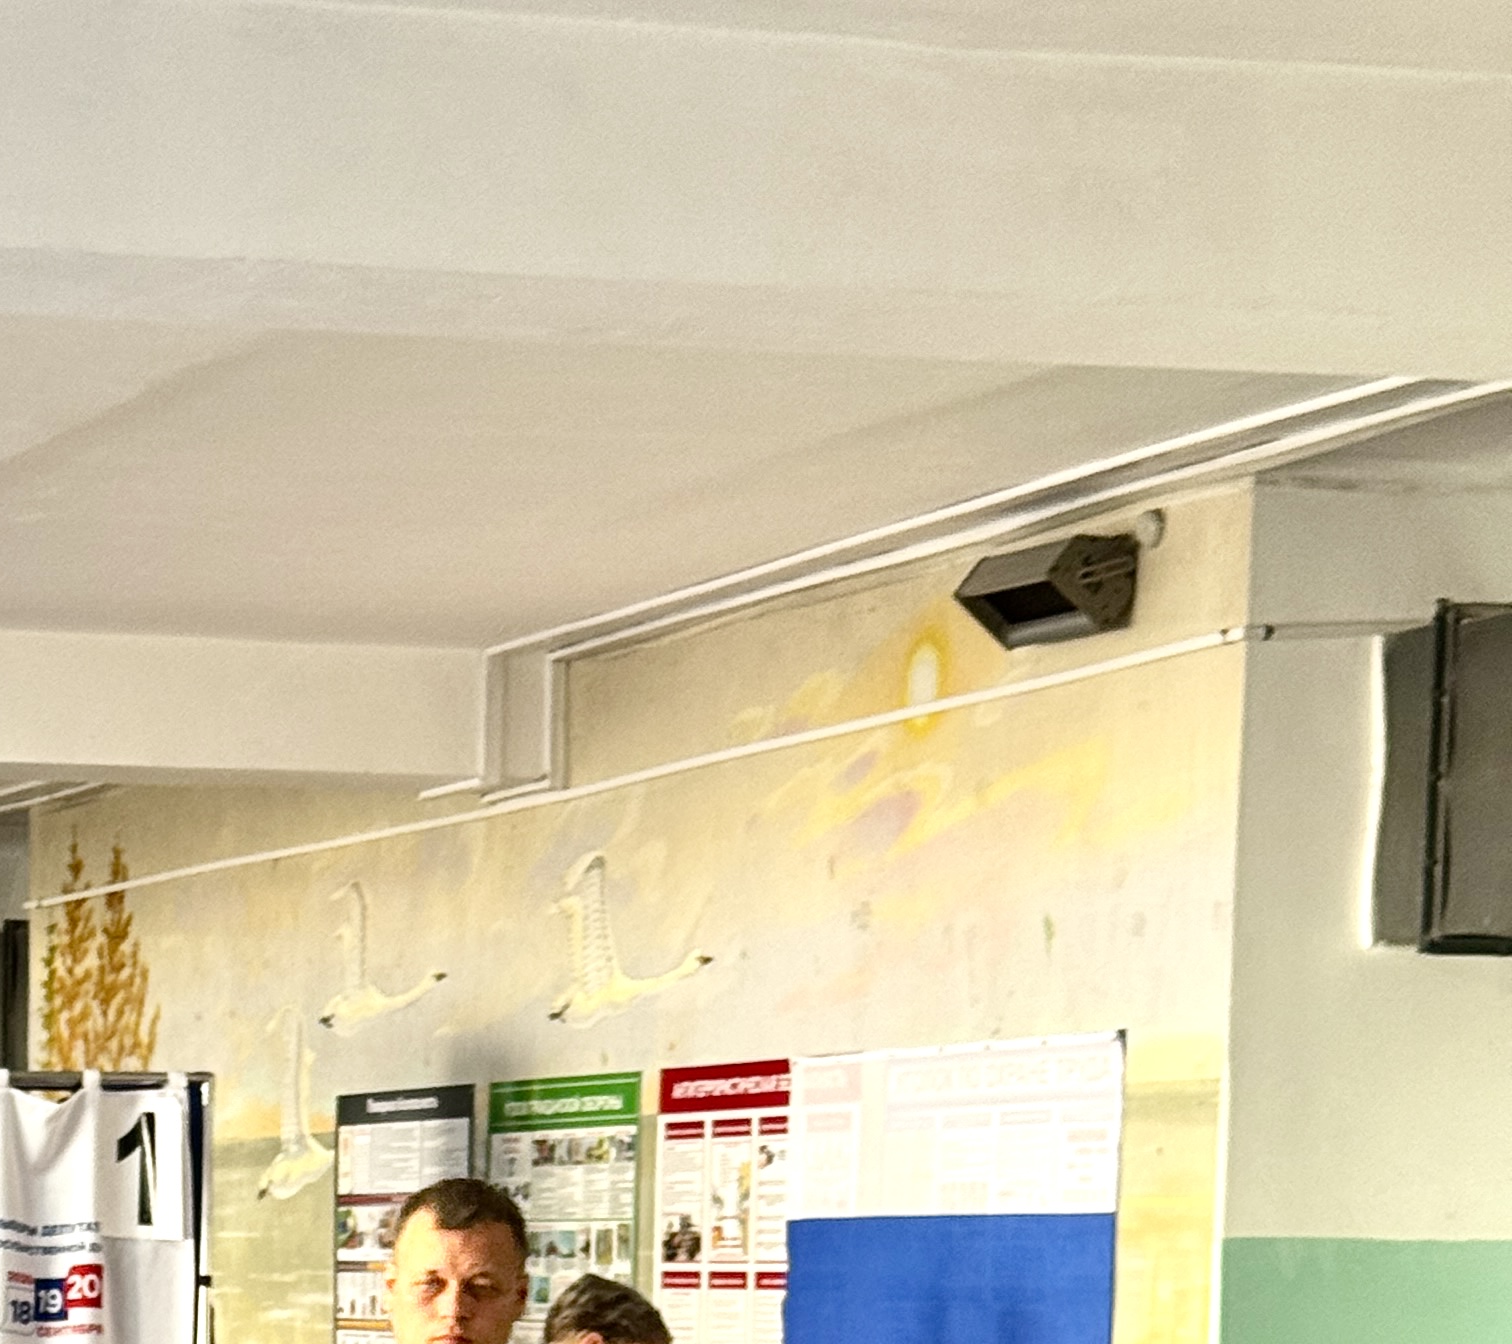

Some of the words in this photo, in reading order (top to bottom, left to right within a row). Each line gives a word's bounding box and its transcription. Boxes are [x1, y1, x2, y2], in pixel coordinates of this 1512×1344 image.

[116, 1111, 157, 1227] 1
[9, 1299, 32, 1325] 18
[38, 1288, 63, 1314] 19
[66, 1273, 101, 1300] 20
